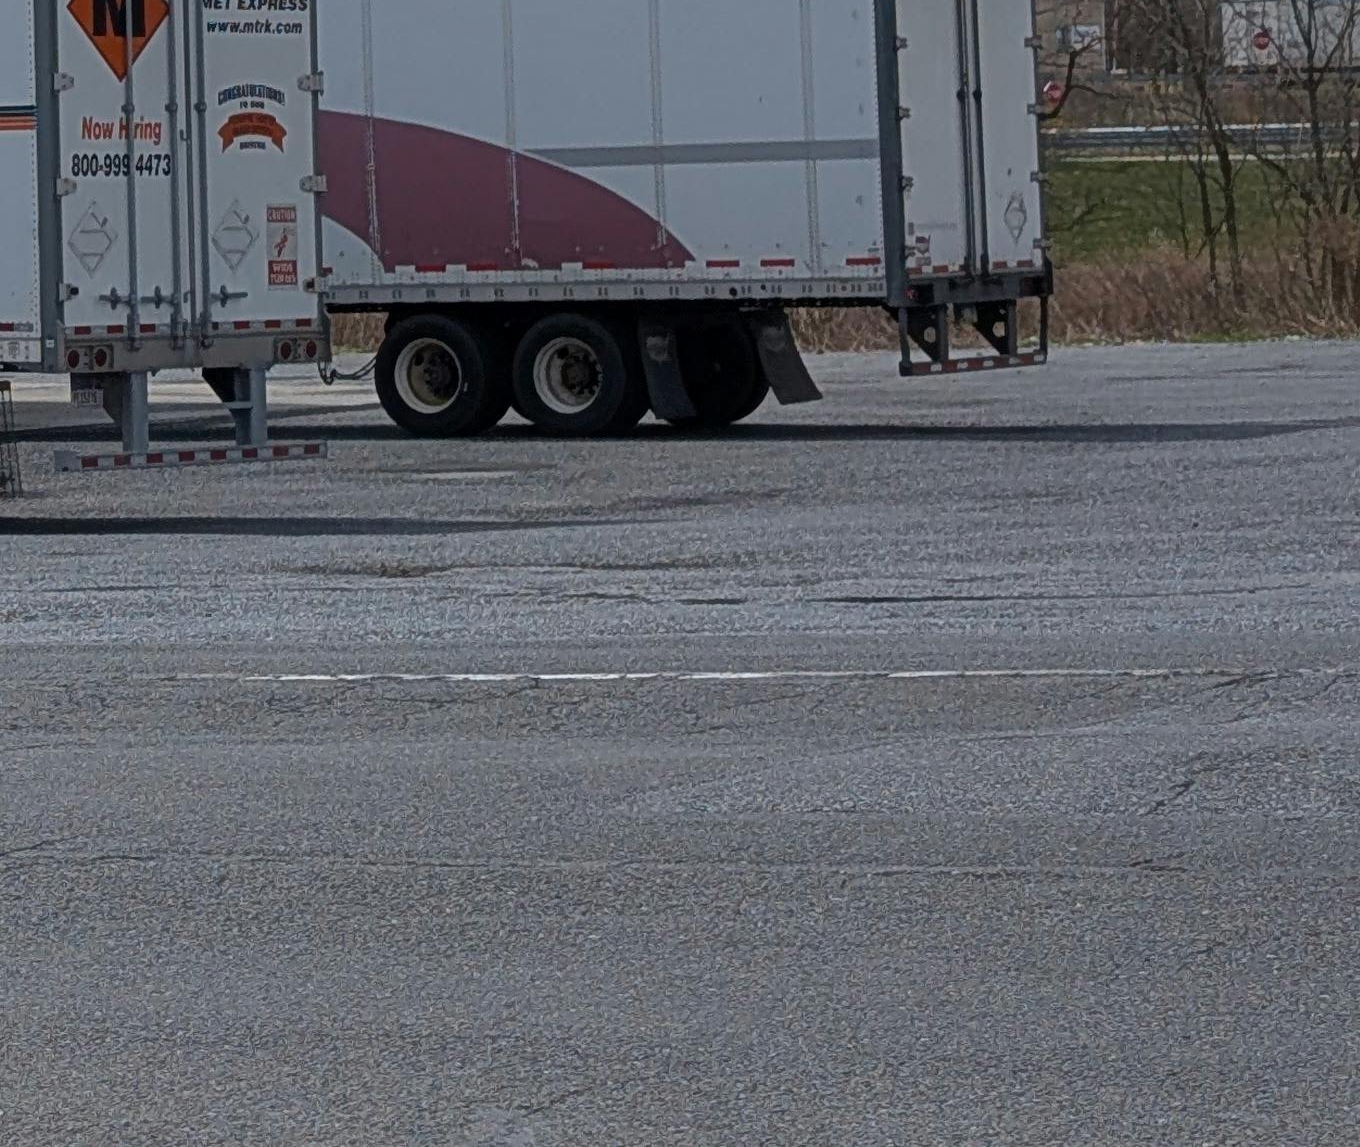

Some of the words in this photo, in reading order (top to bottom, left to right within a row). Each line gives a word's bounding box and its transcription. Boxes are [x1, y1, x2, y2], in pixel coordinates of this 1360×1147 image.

[206, 17, 303, 34] www.mtrk.com
[82, 115, 114, 141] Now
[119, 115, 162, 146] Hring
[71, 153, 171, 177] 800-9994473
